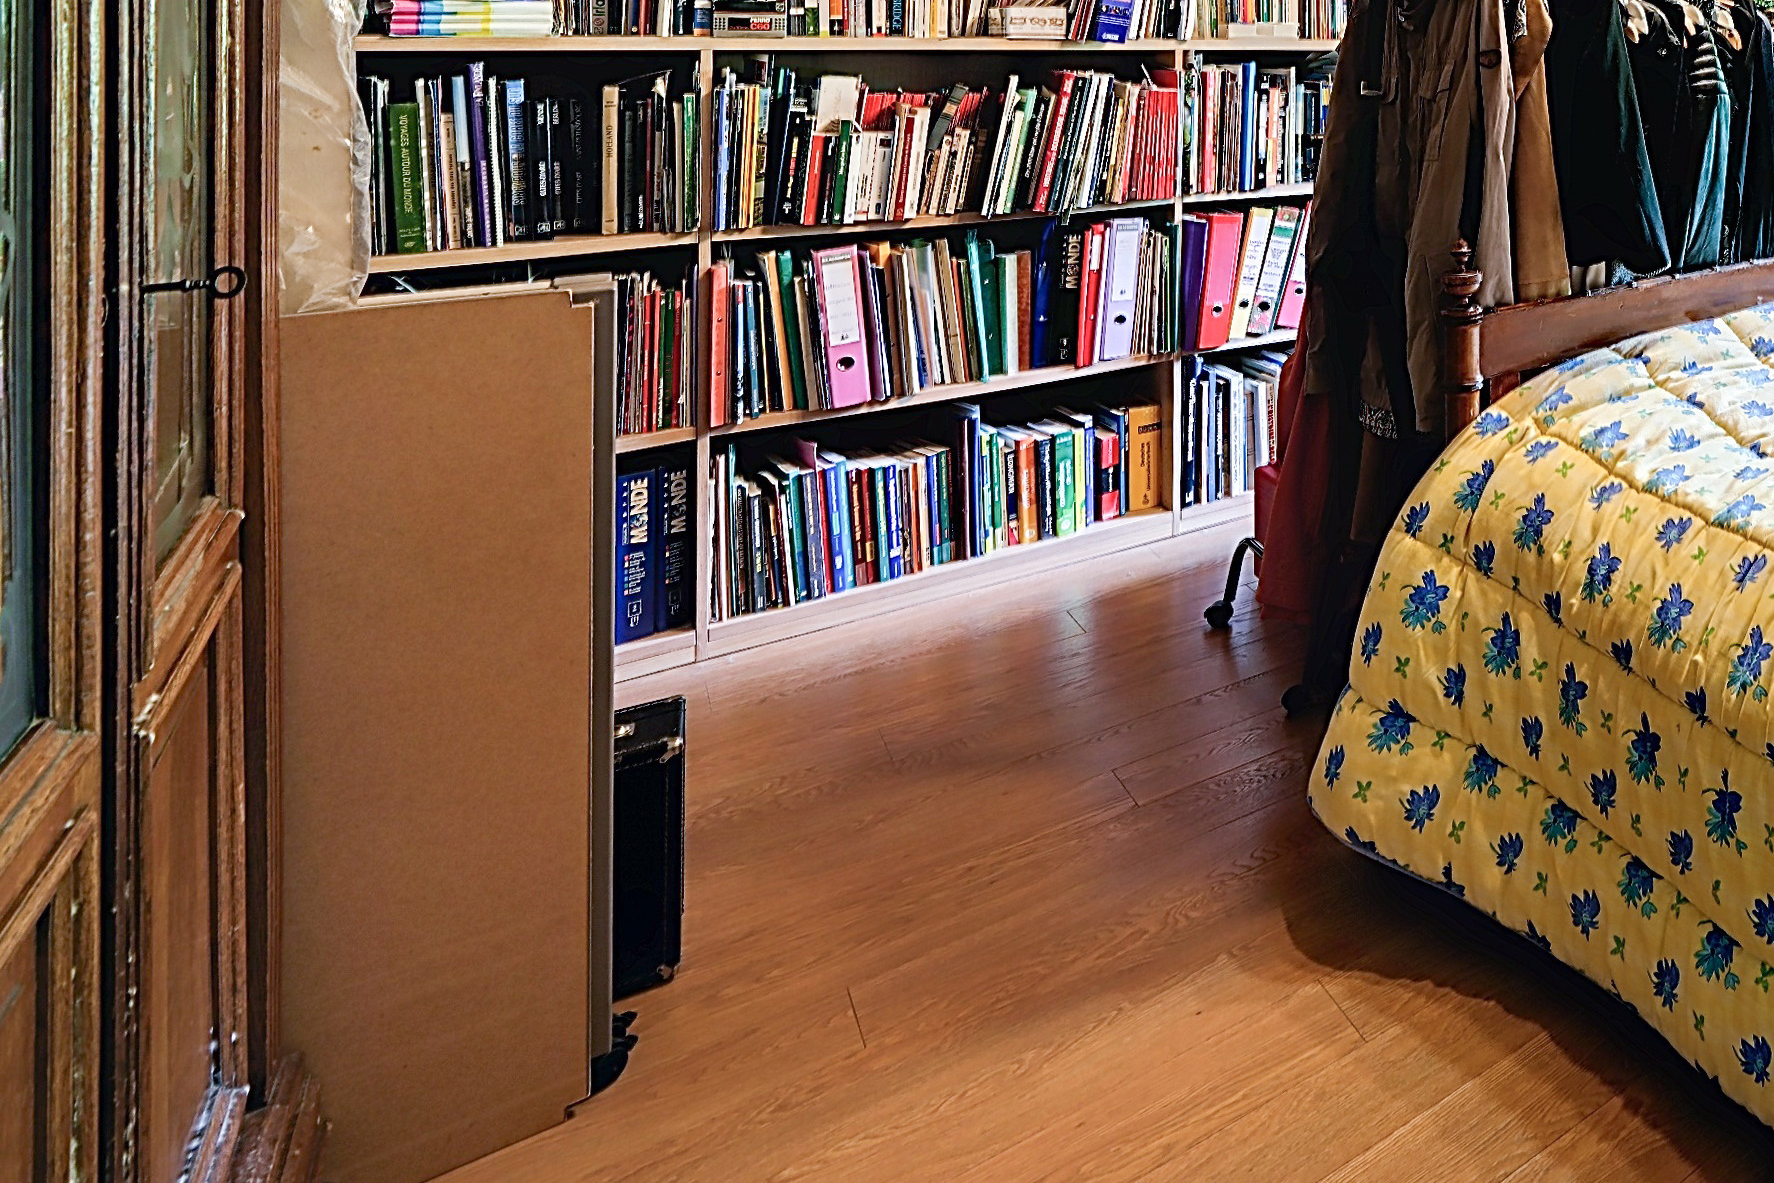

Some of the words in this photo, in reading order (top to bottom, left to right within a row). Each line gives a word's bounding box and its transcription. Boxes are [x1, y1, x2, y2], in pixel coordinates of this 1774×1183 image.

[749, 22, 771, 32] C60
[507, 88, 522, 105] SUD
[399, 114, 409, 147] VOYAGES
[605, 125, 613, 158] HOLLAND
[401, 148, 410, 176] AUTOUR
[403, 177, 411, 188] DU
[403, 188, 412, 214] MONDE
[1065, 234, 1080, 289] MONDE
[1007, 453, 1015, 494] LONGMAN
[629, 477, 649, 545] MONDE
[670, 469, 687, 534] MONDE
